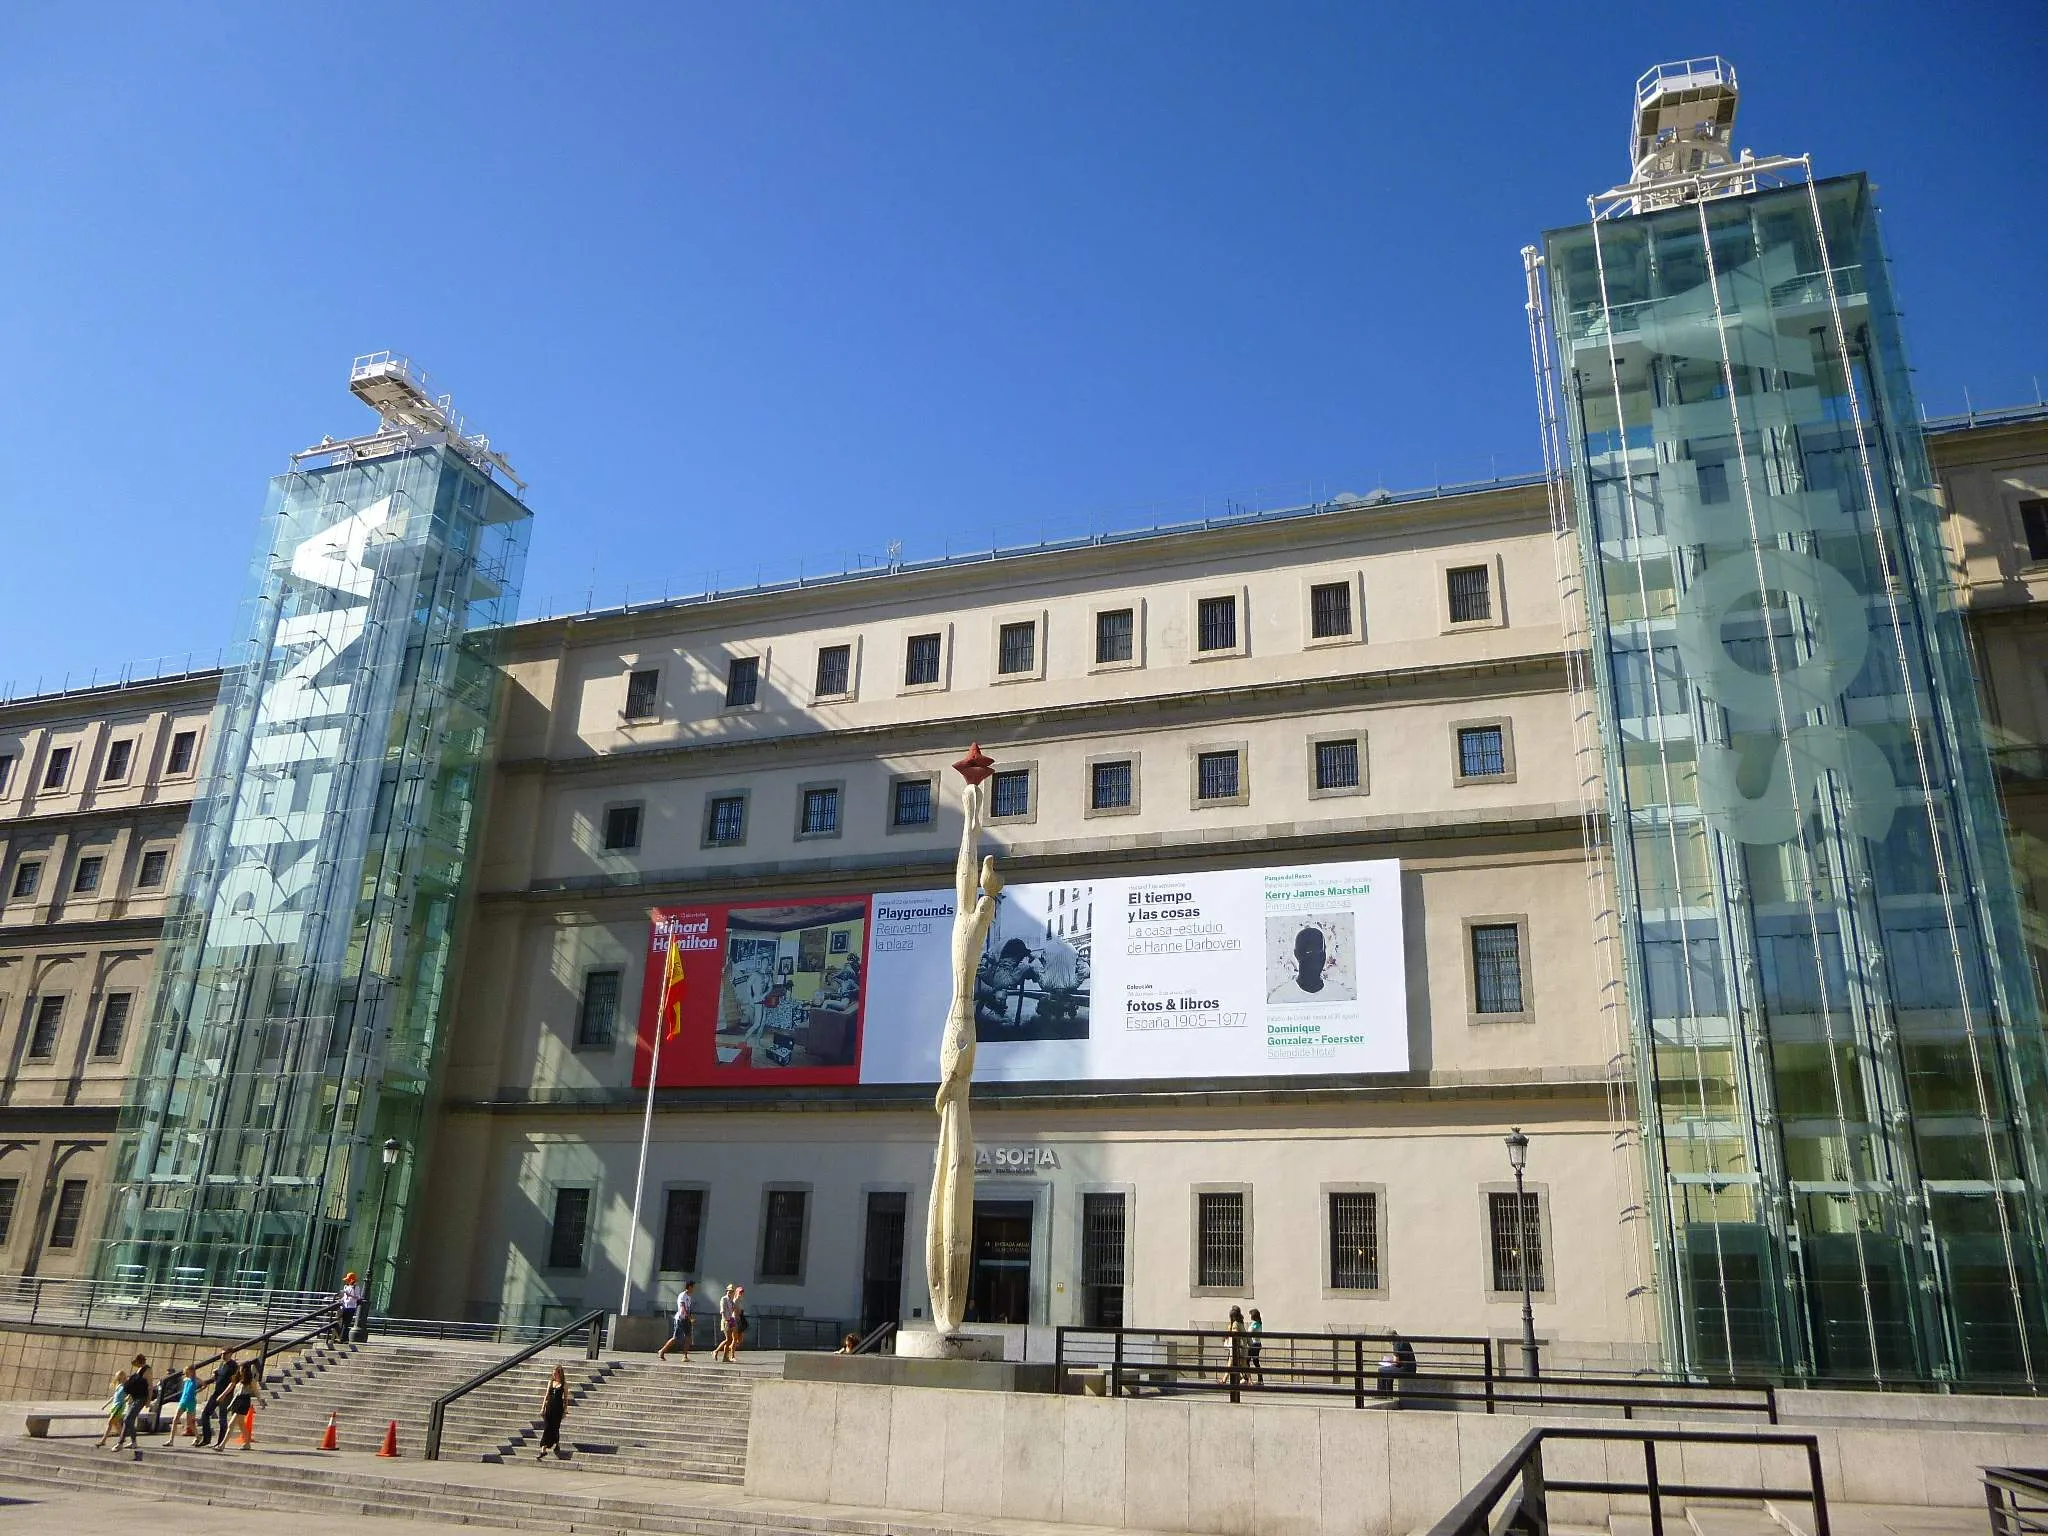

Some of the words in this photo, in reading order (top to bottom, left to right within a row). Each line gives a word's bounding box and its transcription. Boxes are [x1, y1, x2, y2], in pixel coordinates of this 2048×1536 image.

[205, 493, 393, 948] REINA
[1128, 892, 1141, 905] El
[1144, 891, 1192, 905] tiempo
[1265, 891, 1291, 900] Kerry
[1293, 889, 1326, 898] James
[1327, 884, 1370, 896] Marshall
[877, 904, 954, 921] Playgrounds
[1128, 911, 1136, 923] y
[1138, 908, 1158, 920] las
[1160, 908, 1200, 919] cosas
[876, 921, 933, 935] Reinventar
[1128, 924, 1142, 938] La
[875, 938, 884, 950] la
[886, 938, 914, 951] plaza
[1127, 940, 1142, 954] de
[1144, 940, 1183, 953] Hanne
[1185, 937, 1241, 951] Darboven
[1126, 1000, 1163, 1011] fotos
[1165, 998, 1176, 1010] &
[1180, 997, 1220, 1010] libros
[1126, 1015, 1170, 1029] España
[1267, 1024, 1321, 1034] Dominique
[1267, 1035, 1313, 1046] Gonzalez
[1321, 1035, 1364, 1044] Foerster
